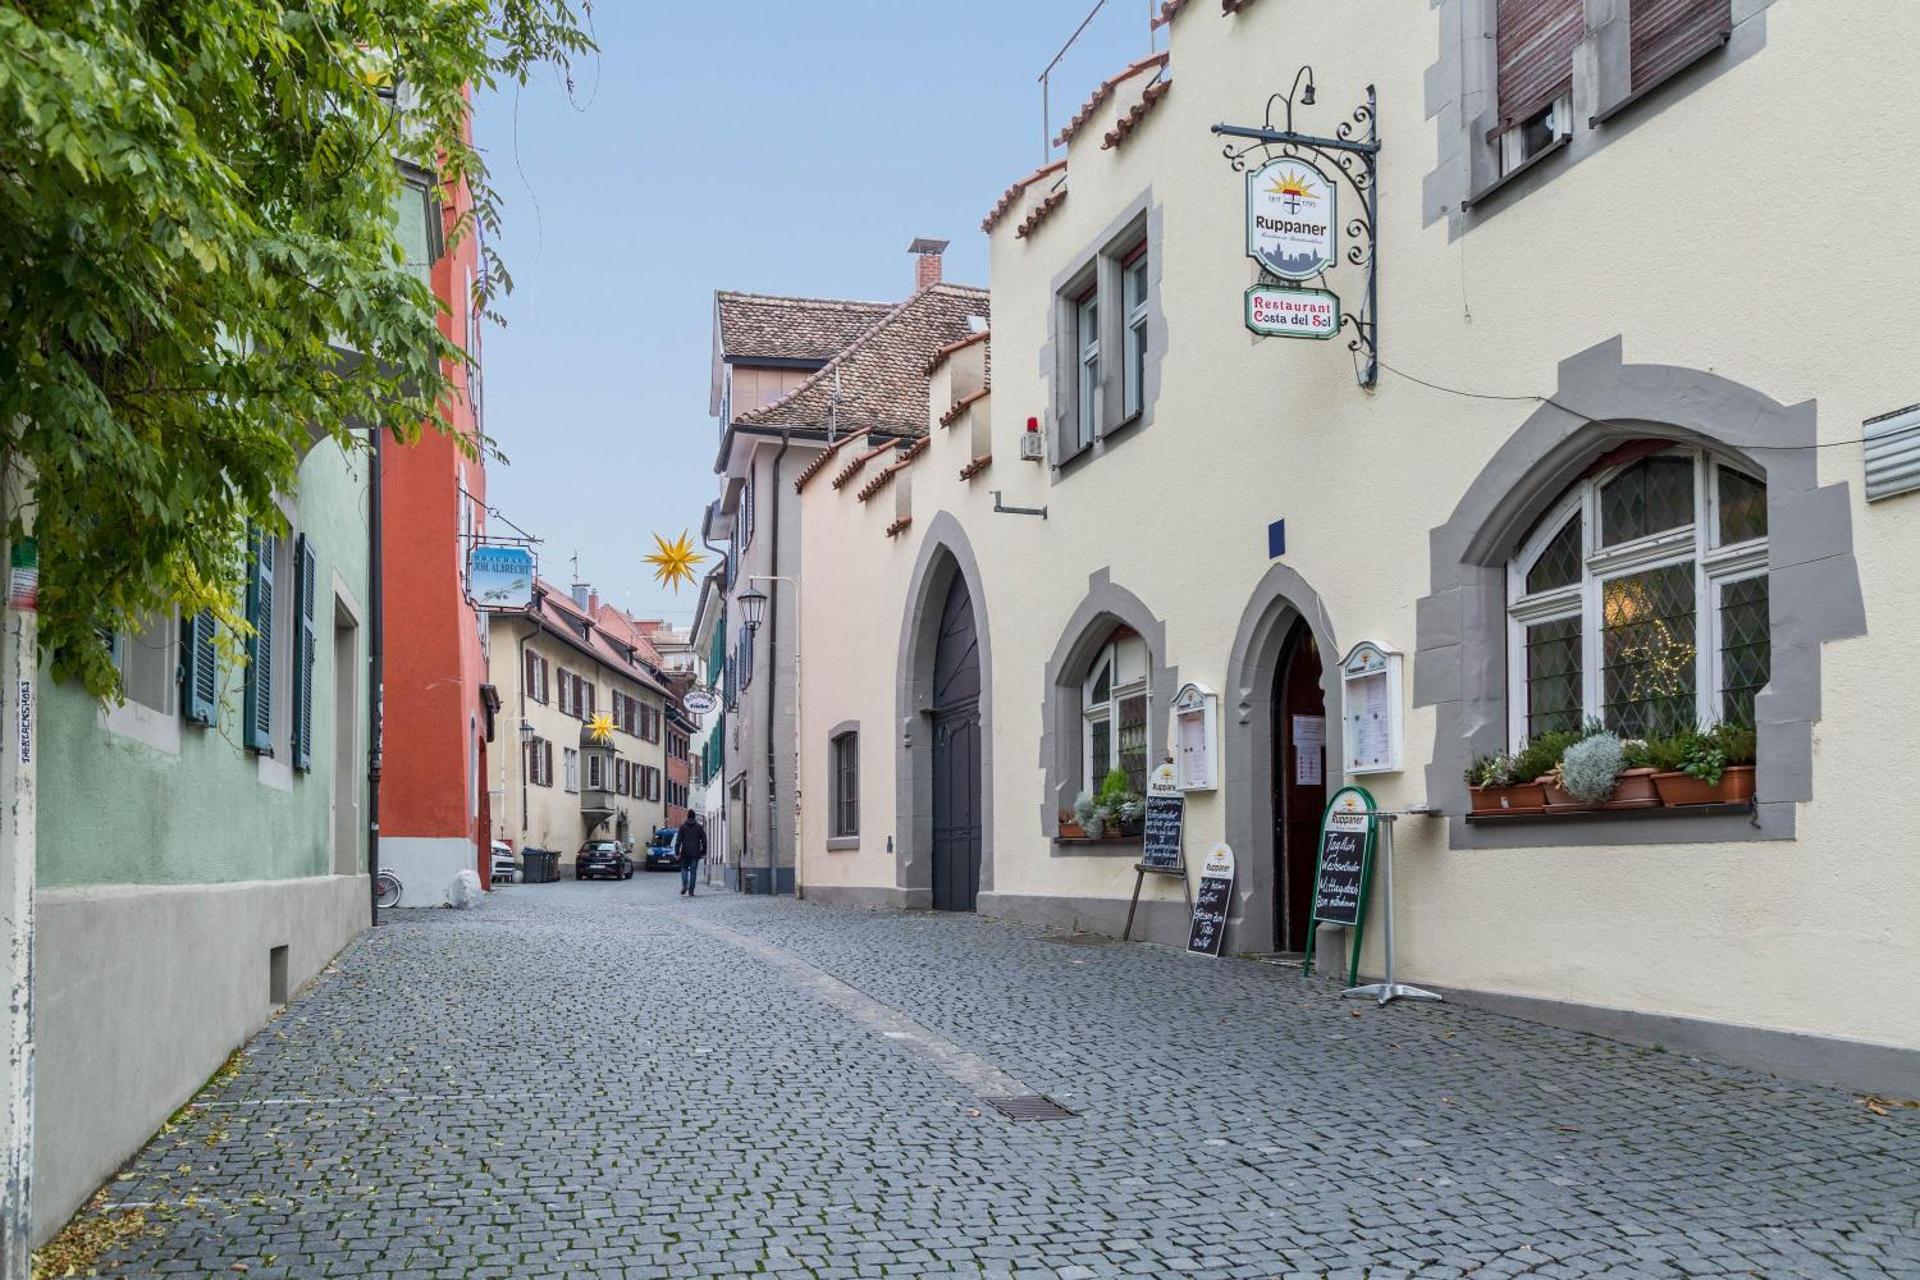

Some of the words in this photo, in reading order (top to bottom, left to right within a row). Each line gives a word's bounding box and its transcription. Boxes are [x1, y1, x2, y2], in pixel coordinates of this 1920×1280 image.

[1256, 215, 1327, 236] Ruppaner
[1254, 296, 1330, 313] Restaurant
[1254, 310, 1287, 324] Costa
[1291, 313, 1308, 326] del
[1312, 314, 1331, 327] Sol
[492, 563, 529, 574] ALBRECHT
[1332, 814, 1363, 825] Ruppaner
